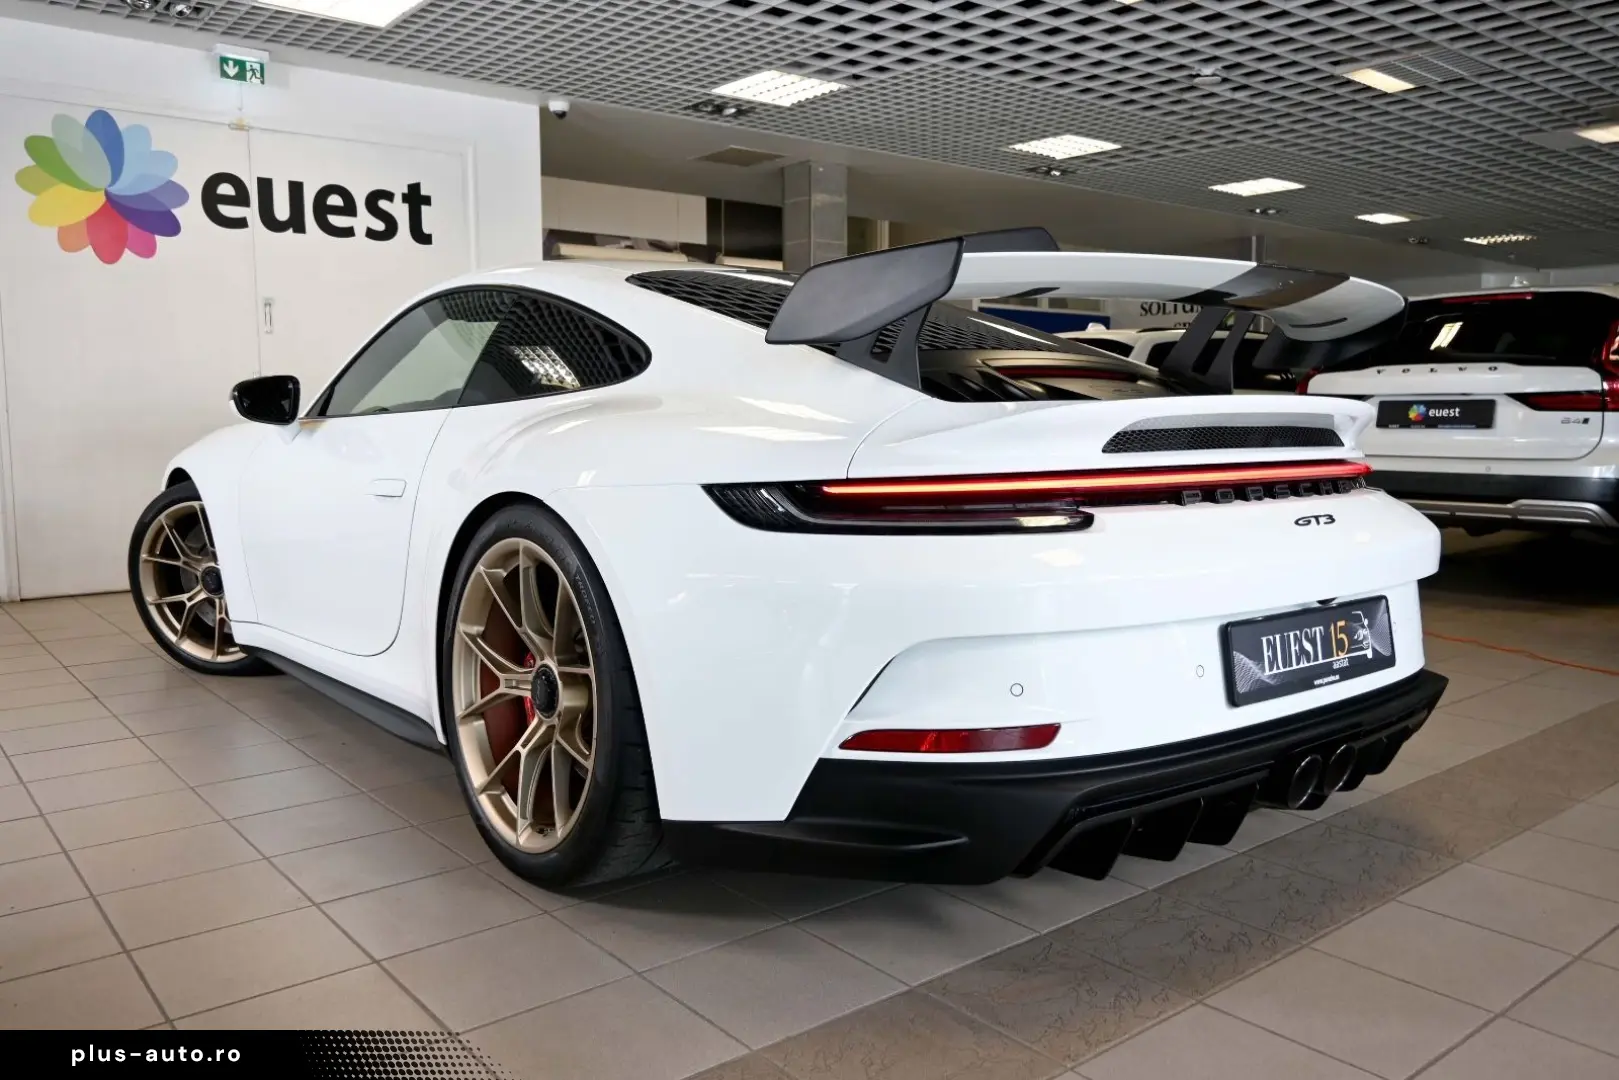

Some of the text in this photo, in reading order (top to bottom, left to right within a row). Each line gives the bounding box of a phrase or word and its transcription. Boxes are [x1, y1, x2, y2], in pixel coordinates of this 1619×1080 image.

[201, 172, 432, 245] euest
[1377, 365, 1498, 375] VOLVO
[1428, 407, 1460, 417] euest
[1181, 479, 1351, 506] PORSCHE
[1294, 513, 1336, 526] GT3
[1261, 620, 1349, 675] EUEST 15
